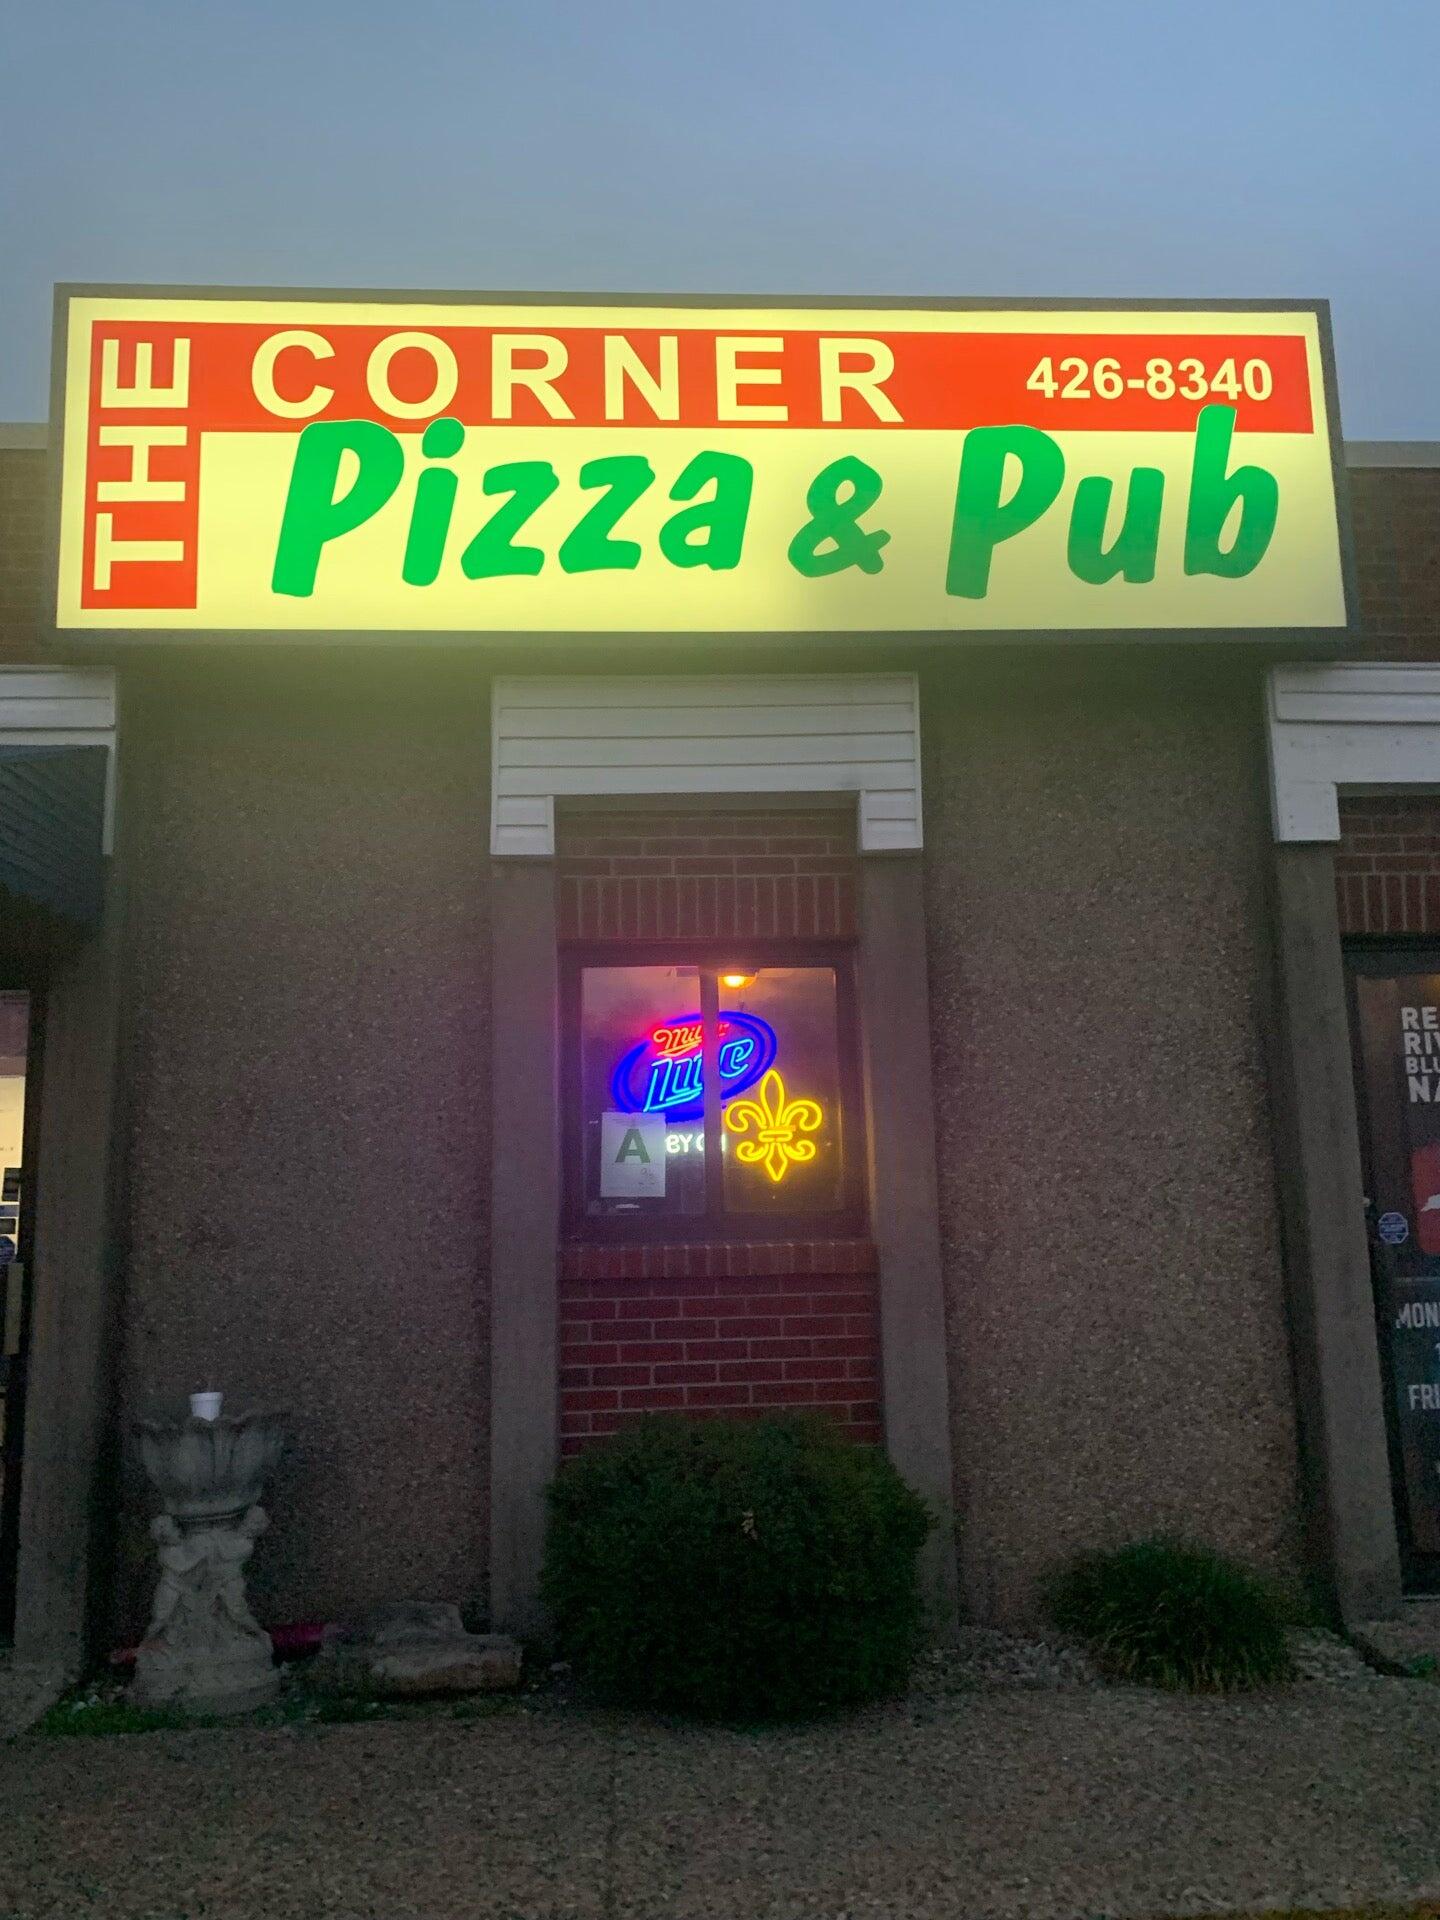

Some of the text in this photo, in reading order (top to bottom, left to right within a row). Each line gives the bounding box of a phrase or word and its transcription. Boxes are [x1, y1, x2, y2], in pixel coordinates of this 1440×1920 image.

[251, 329, 905, 423] CORNER
[1026, 356, 1273, 401] 426-8340
[94, 337, 190, 590] THE
[271, 405, 1280, 599] Pizza & Pub
[615, 1128, 651, 1163] A
